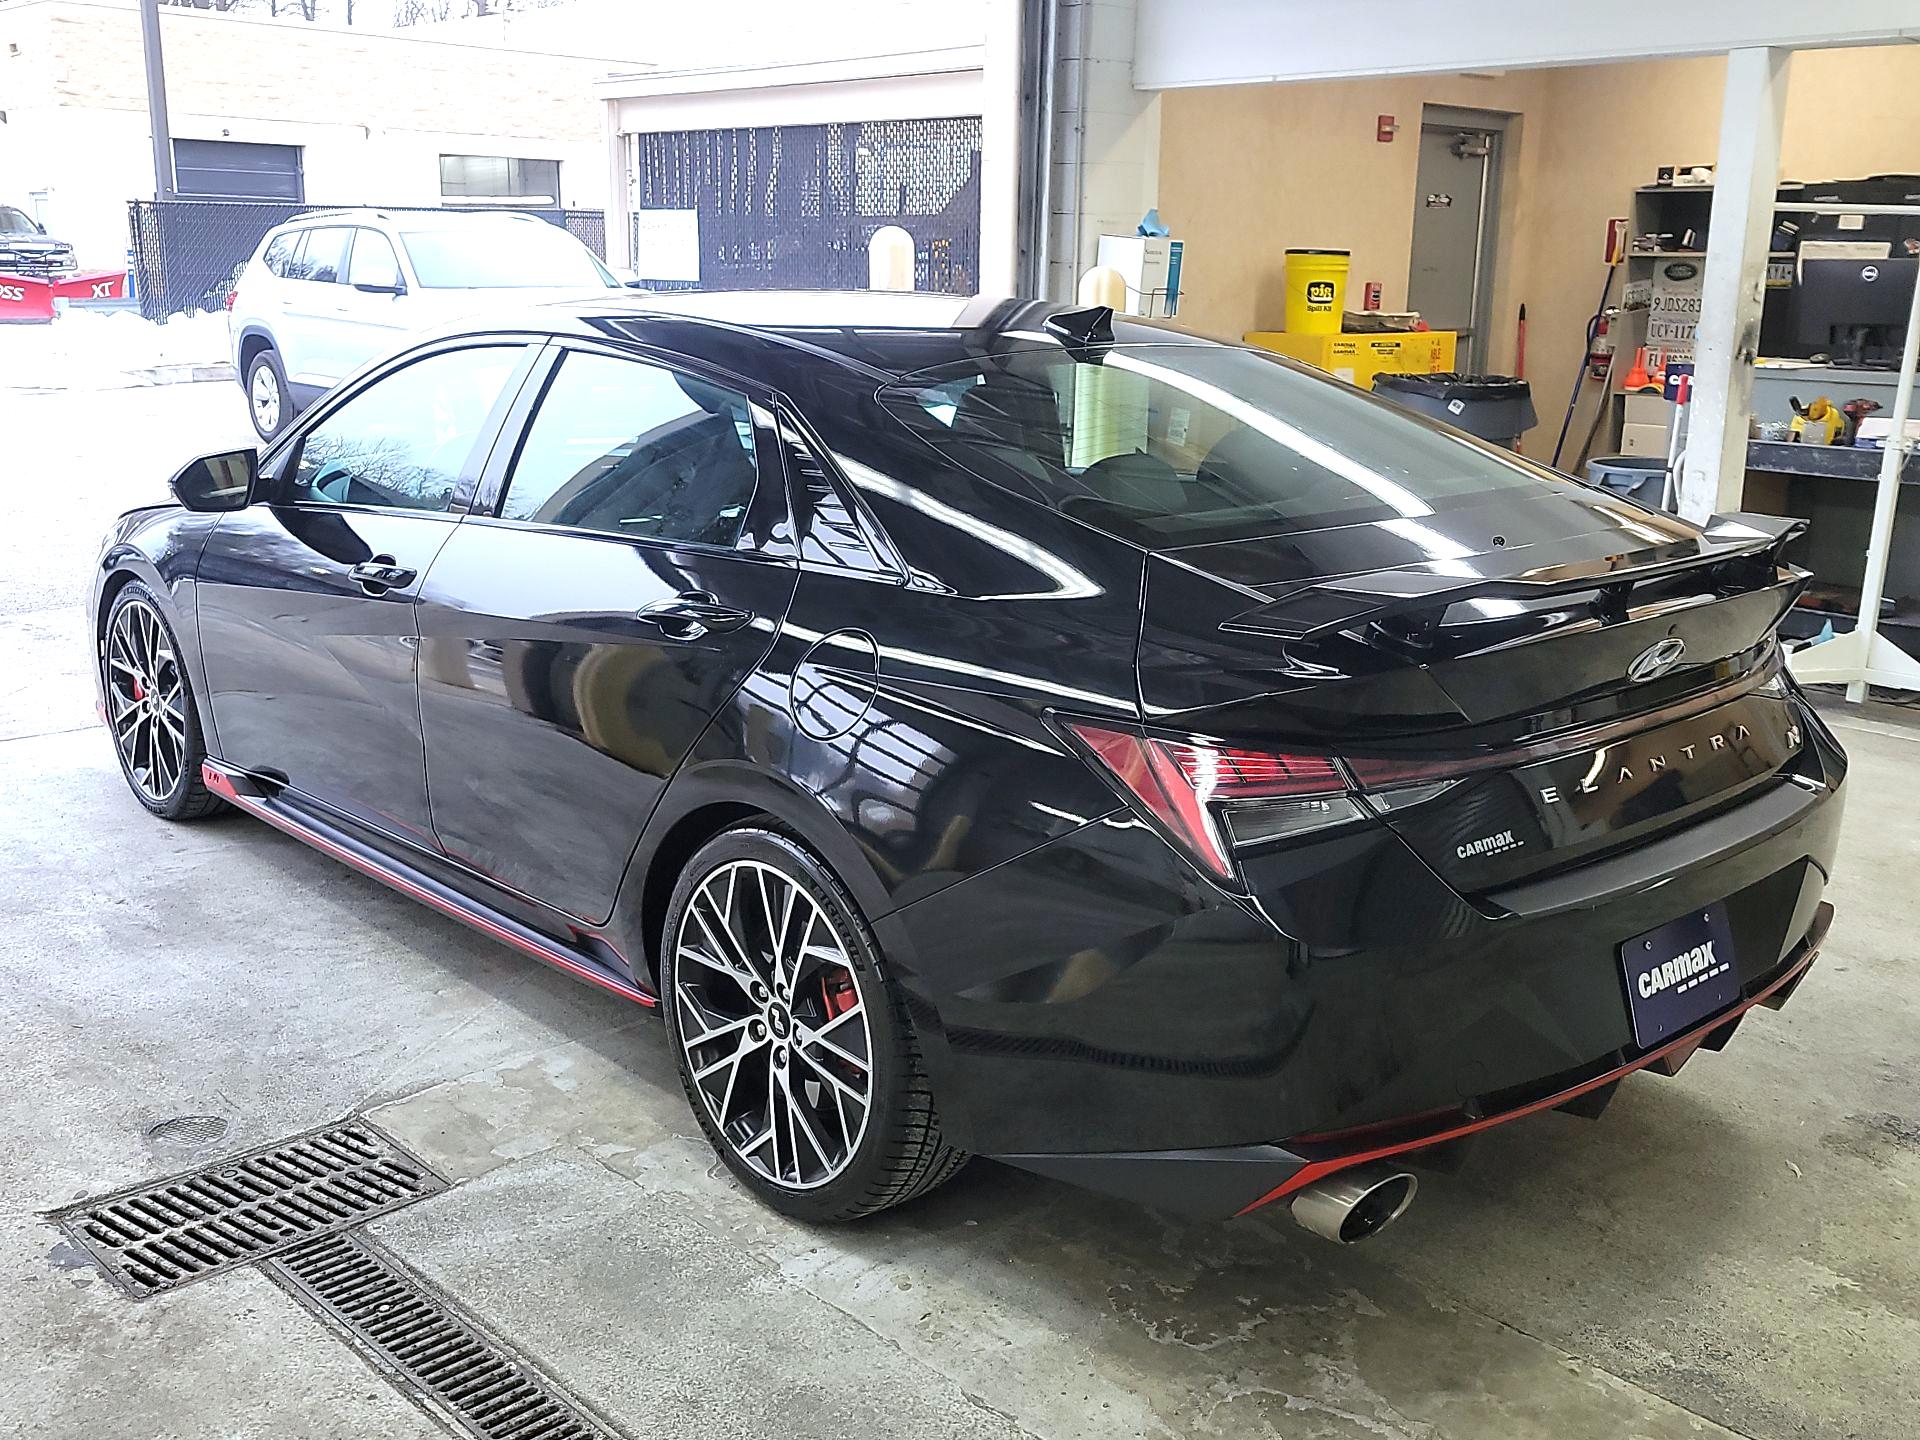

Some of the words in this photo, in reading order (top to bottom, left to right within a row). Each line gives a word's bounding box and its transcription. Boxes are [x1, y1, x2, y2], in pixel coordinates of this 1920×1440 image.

[0, 284, 25, 301] SS
[91, 281, 115, 299] XT
[1310, 283, 1333, 301] pig
[1540, 725, 1752, 805] ELANTRA
